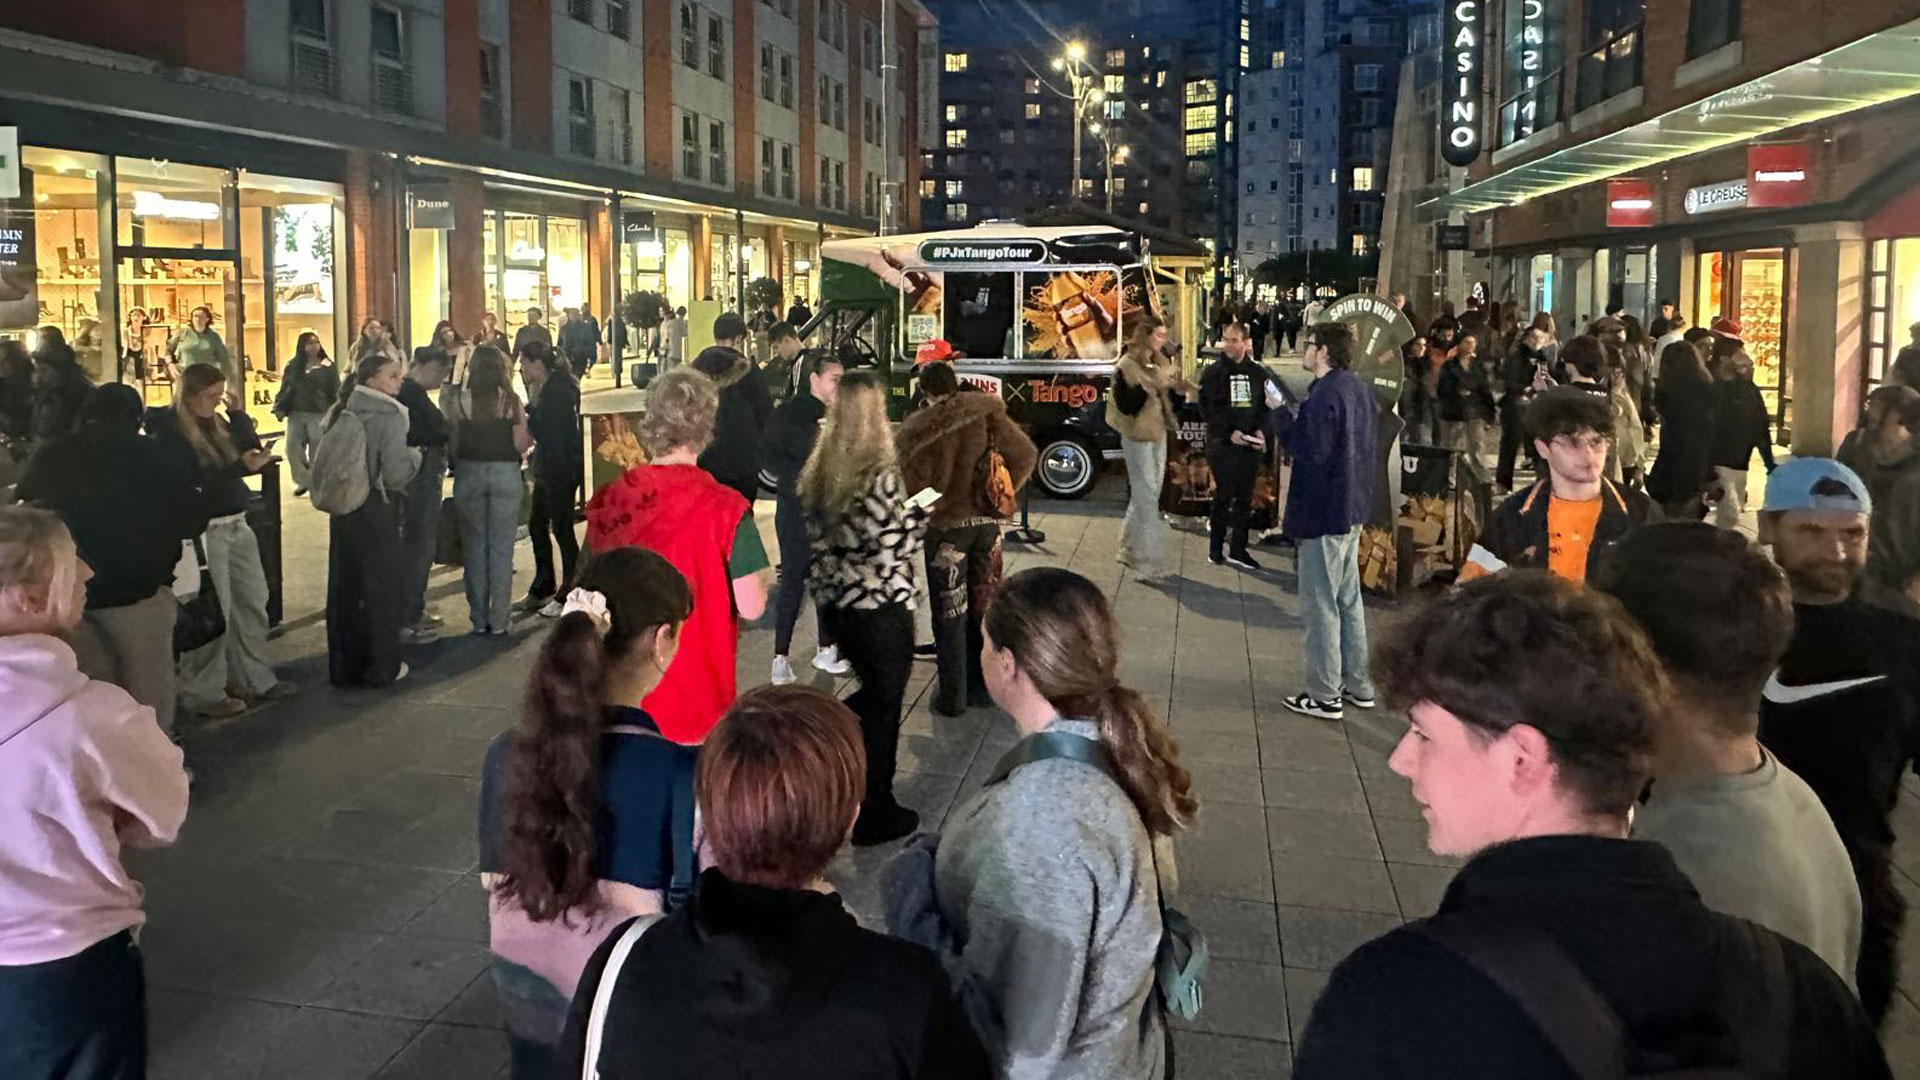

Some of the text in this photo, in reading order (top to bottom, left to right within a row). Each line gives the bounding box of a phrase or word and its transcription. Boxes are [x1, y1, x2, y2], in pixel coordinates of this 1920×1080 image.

[1450, 1, 1476, 147] CASINO
[416, 199, 450, 209] Dune
[1698, 184, 1748, 205] LE CREUSE
[933, 246, 1033, 259] #PJxTangoTour
[1329, 298, 1397, 324] SPIN TO WIN
[1027, 380, 1098, 408] Tango
[1175, 430, 1204, 441] YOU
